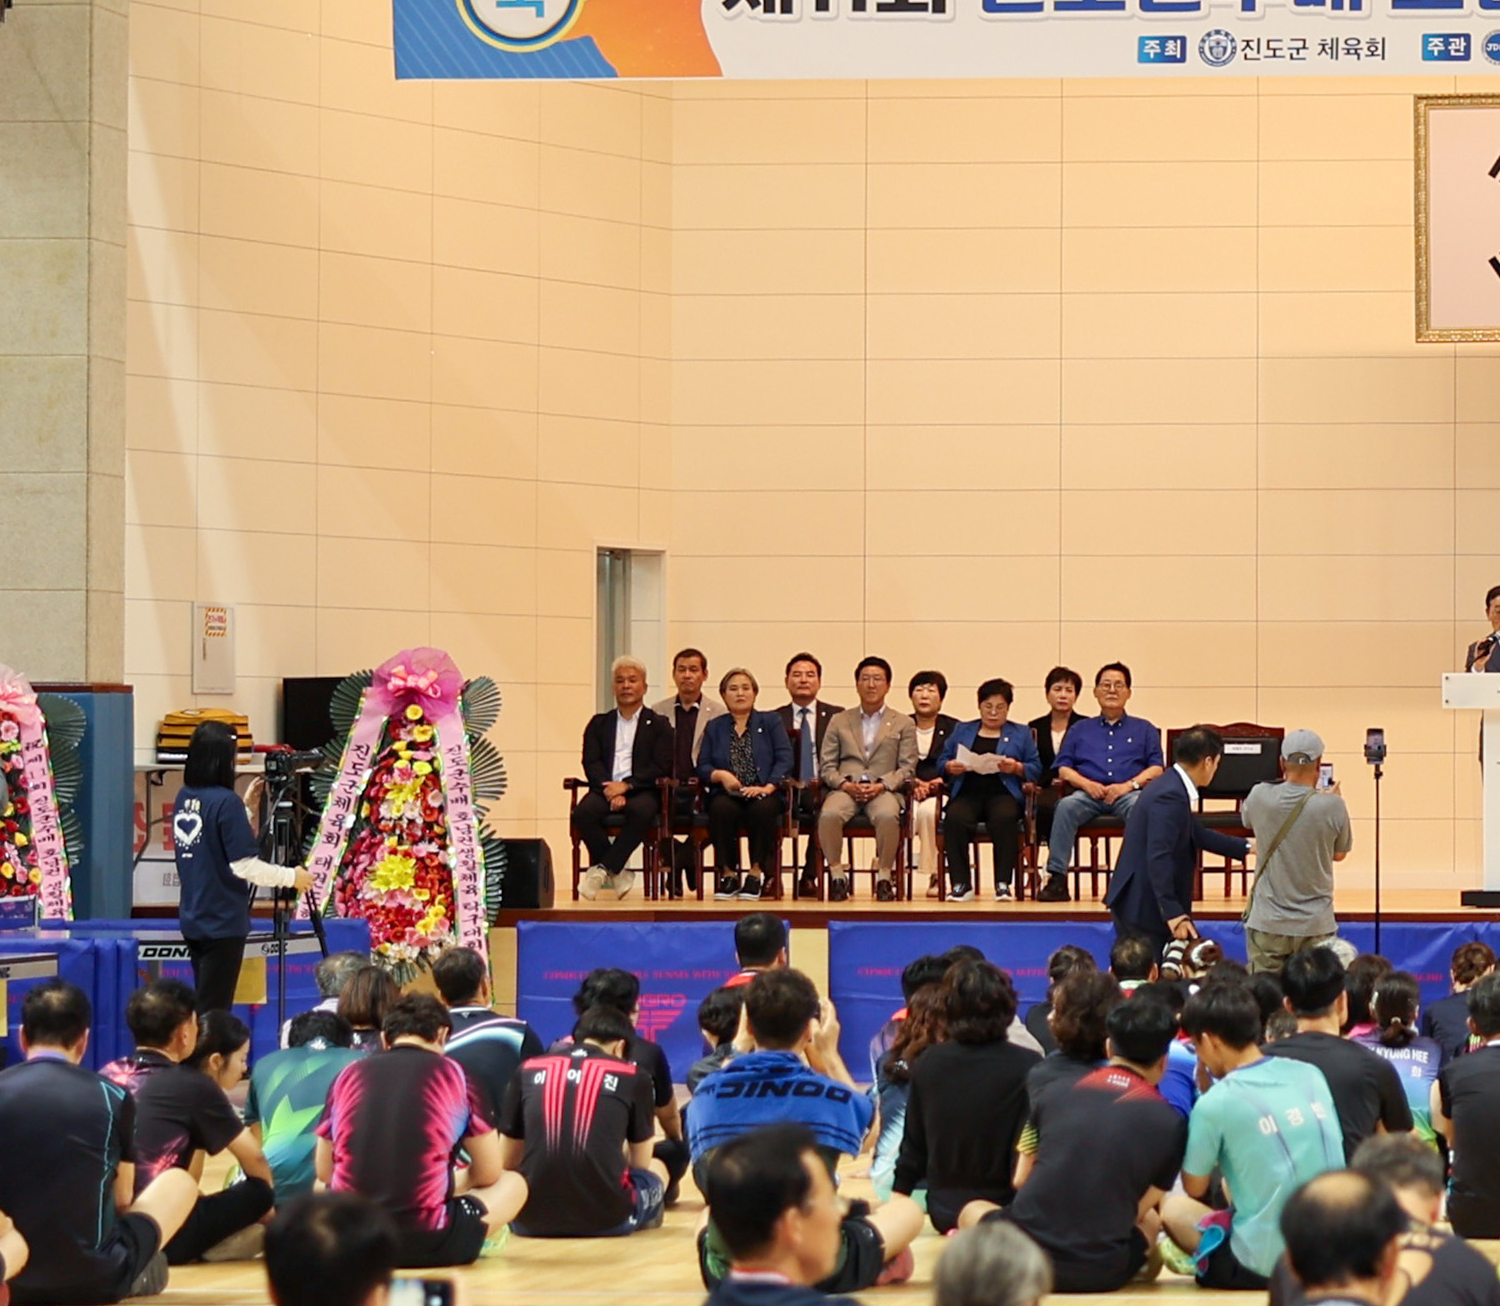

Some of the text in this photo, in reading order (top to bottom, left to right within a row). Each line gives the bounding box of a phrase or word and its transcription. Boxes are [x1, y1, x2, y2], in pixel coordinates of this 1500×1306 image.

[1143, 39, 1183, 59] 주최
[1240, 37, 1311, 62] 진도군
[1317, 36, 1388, 62] 체육회
[1426, 37, 1467, 58] 주관
